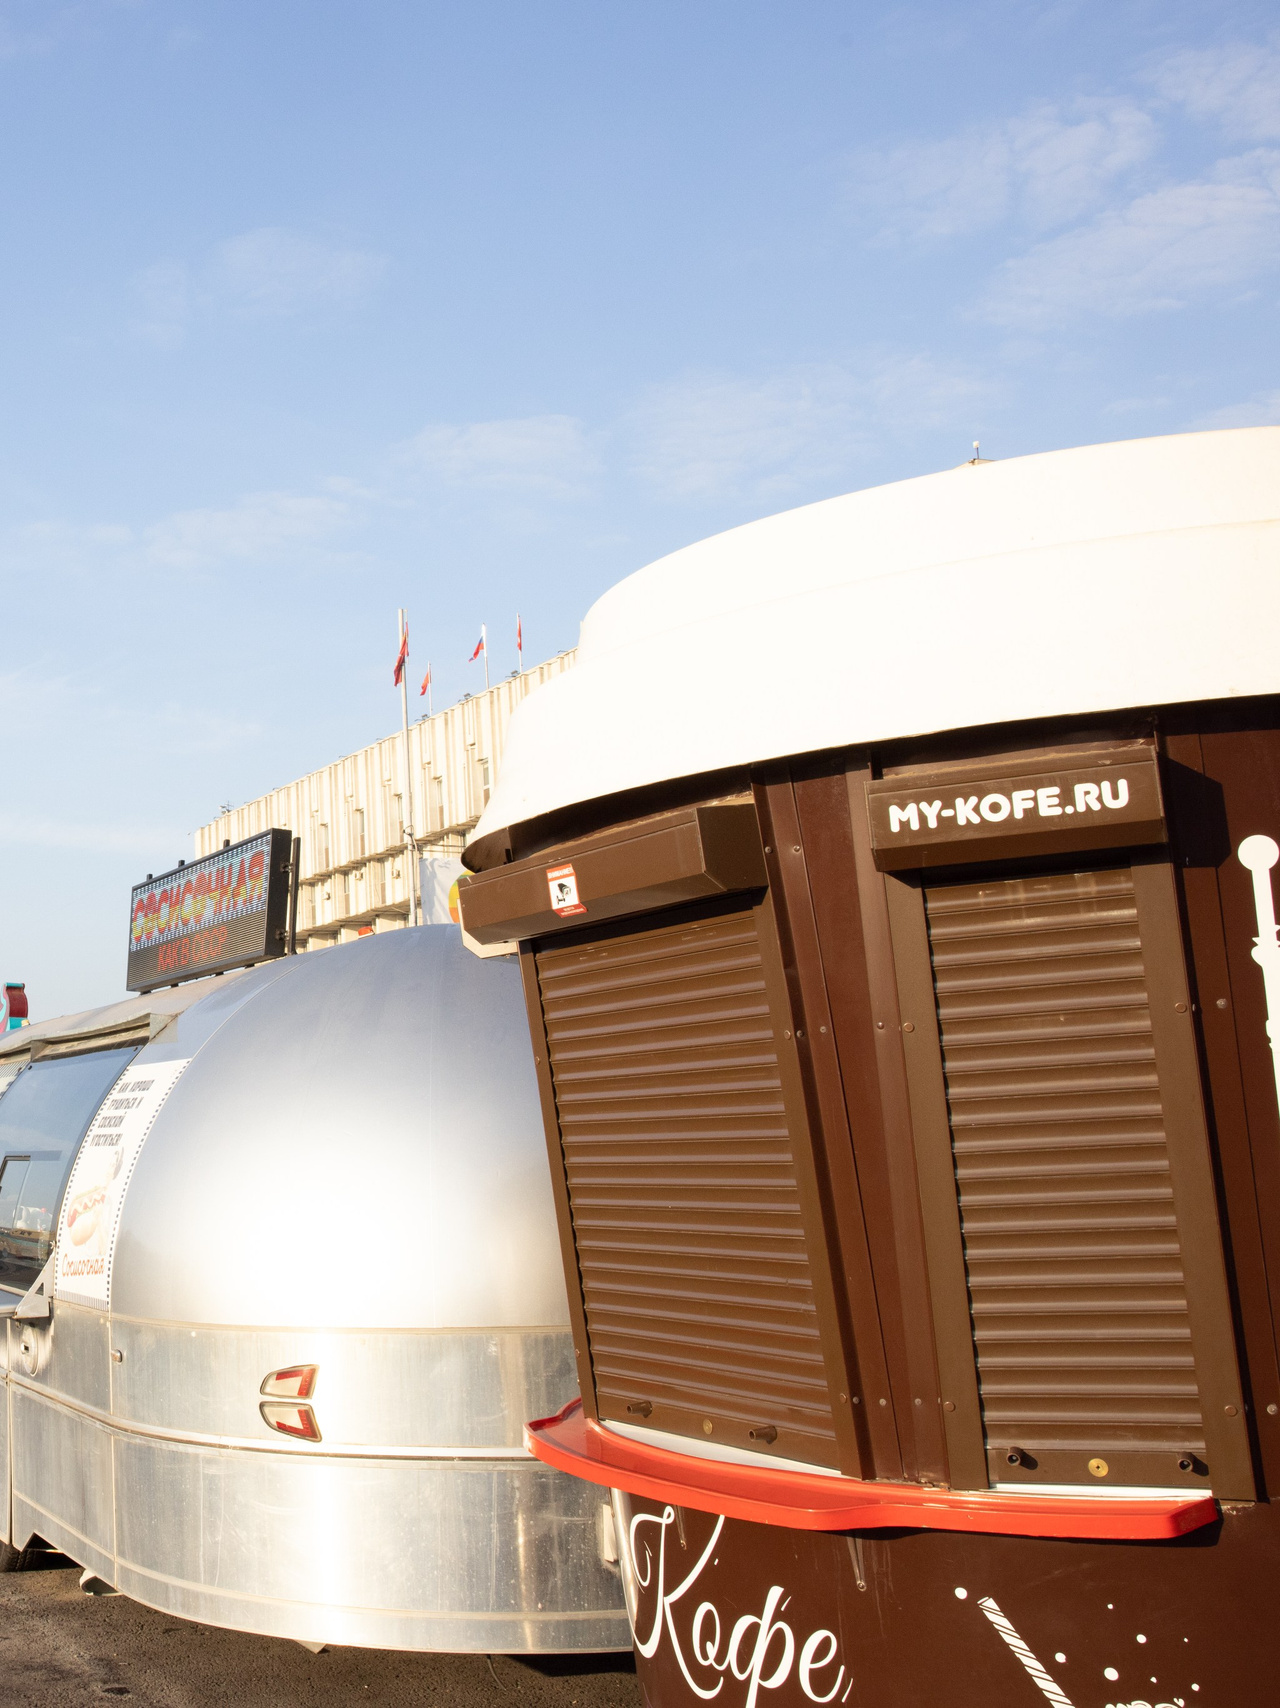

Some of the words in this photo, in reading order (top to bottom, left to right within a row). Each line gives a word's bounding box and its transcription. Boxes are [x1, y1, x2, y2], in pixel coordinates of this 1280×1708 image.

[888, 779, 1130, 832] MY-KOFE.RU
[132, 850, 265, 943] СОСИСОЧНАЯ
[158, 940, 181, 971] КАК
[181, 938, 190, 965] В
[192, 926, 228, 962] СССР
[98, 1111, 127, 1128] СОСИСКОЙ
[622, 1505, 847, 1708] Кофе
